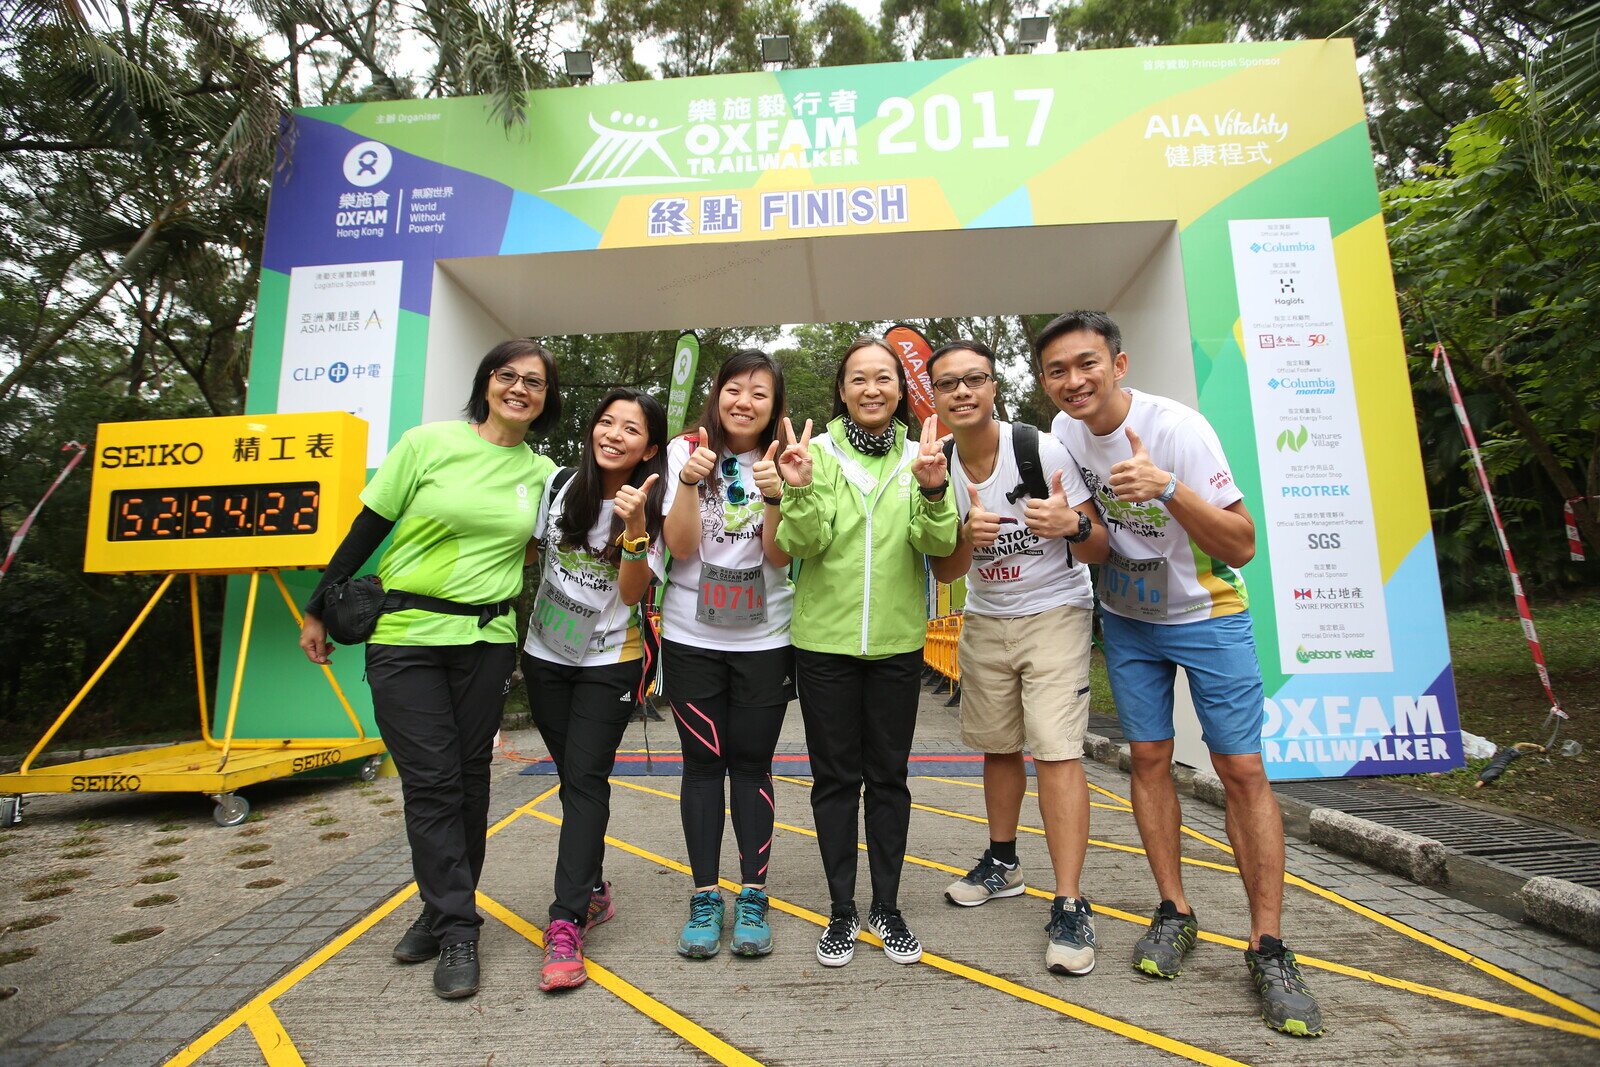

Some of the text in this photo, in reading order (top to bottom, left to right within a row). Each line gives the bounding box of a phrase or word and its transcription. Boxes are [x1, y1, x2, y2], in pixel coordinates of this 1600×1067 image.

[1192, 57, 1281, 70] Principal Sponsor
[687, 89, 858, 121] 樂施毅行者
[398, 111, 442, 125] Organiser
[685, 88, 1056, 155] OXFAM 2017
[1143, 108, 1289, 142] AIA Vitality
[687, 147, 860, 176] TRAILWALKER
[1164, 142, 1272, 168] 健康程式
[338, 192, 391, 209] 樂施會
[410, 202, 437, 213] World
[758, 184, 909, 231] FINISH
[335, 209, 388, 227] OXFAM
[409, 212, 446, 223] Without
[648, 194, 743, 237] 終點
[336, 227, 384, 239] Hong Kong
[408, 223, 444, 235] Poverty
[1262, 242, 1315, 253] Columbia
[314, 280, 376, 290] Logistics Sponsors
[301, 310, 360, 323] 亞洲萬里通
[300, 322, 359, 334] ASIA MILES
[897, 341, 924, 373] AIA
[293, 366, 325, 381] CLP
[353, 363, 381, 379] 中電
[1280, 377, 1335, 389] Columbia
[1295, 387, 1336, 396] montrail
[1310, 432, 1343, 440] Natures
[232, 433, 335, 463] 精工表
[1312, 440, 1340, 449] Village
[101, 442, 204, 469] SEIKO
[1328, 472, 1343, 480] Shop
[1281, 484, 1351, 498] PROTREK
[1311, 519, 1345, 527] Management
[981, 534, 1040, 557] MANIAC'S
[1307, 532, 1341, 550] SGS
[1130, 561, 1160, 573] 2017
[743, 569, 761, 582] 2017
[1325, 571, 1349, 579] Sponsor
[1103, 564, 1146, 603] 1071
[703, 580, 763, 610] 1071 A
[1315, 586, 1364, 600] 太古地產
[569, 602, 596, 619] 2017
[1320, 601, 1365, 610] PROPERTIES
[535, 598, 577, 641] 1071
[1342, 632, 1366, 640] Sponsor
[1299, 648, 1375, 660] watsons water
[1261, 694, 1447, 738] OXFAM
[1262, 737, 1450, 763] RAILWALKER
[292, 749, 341, 773] SEIKO
[71, 774, 141, 792] SEIKO
